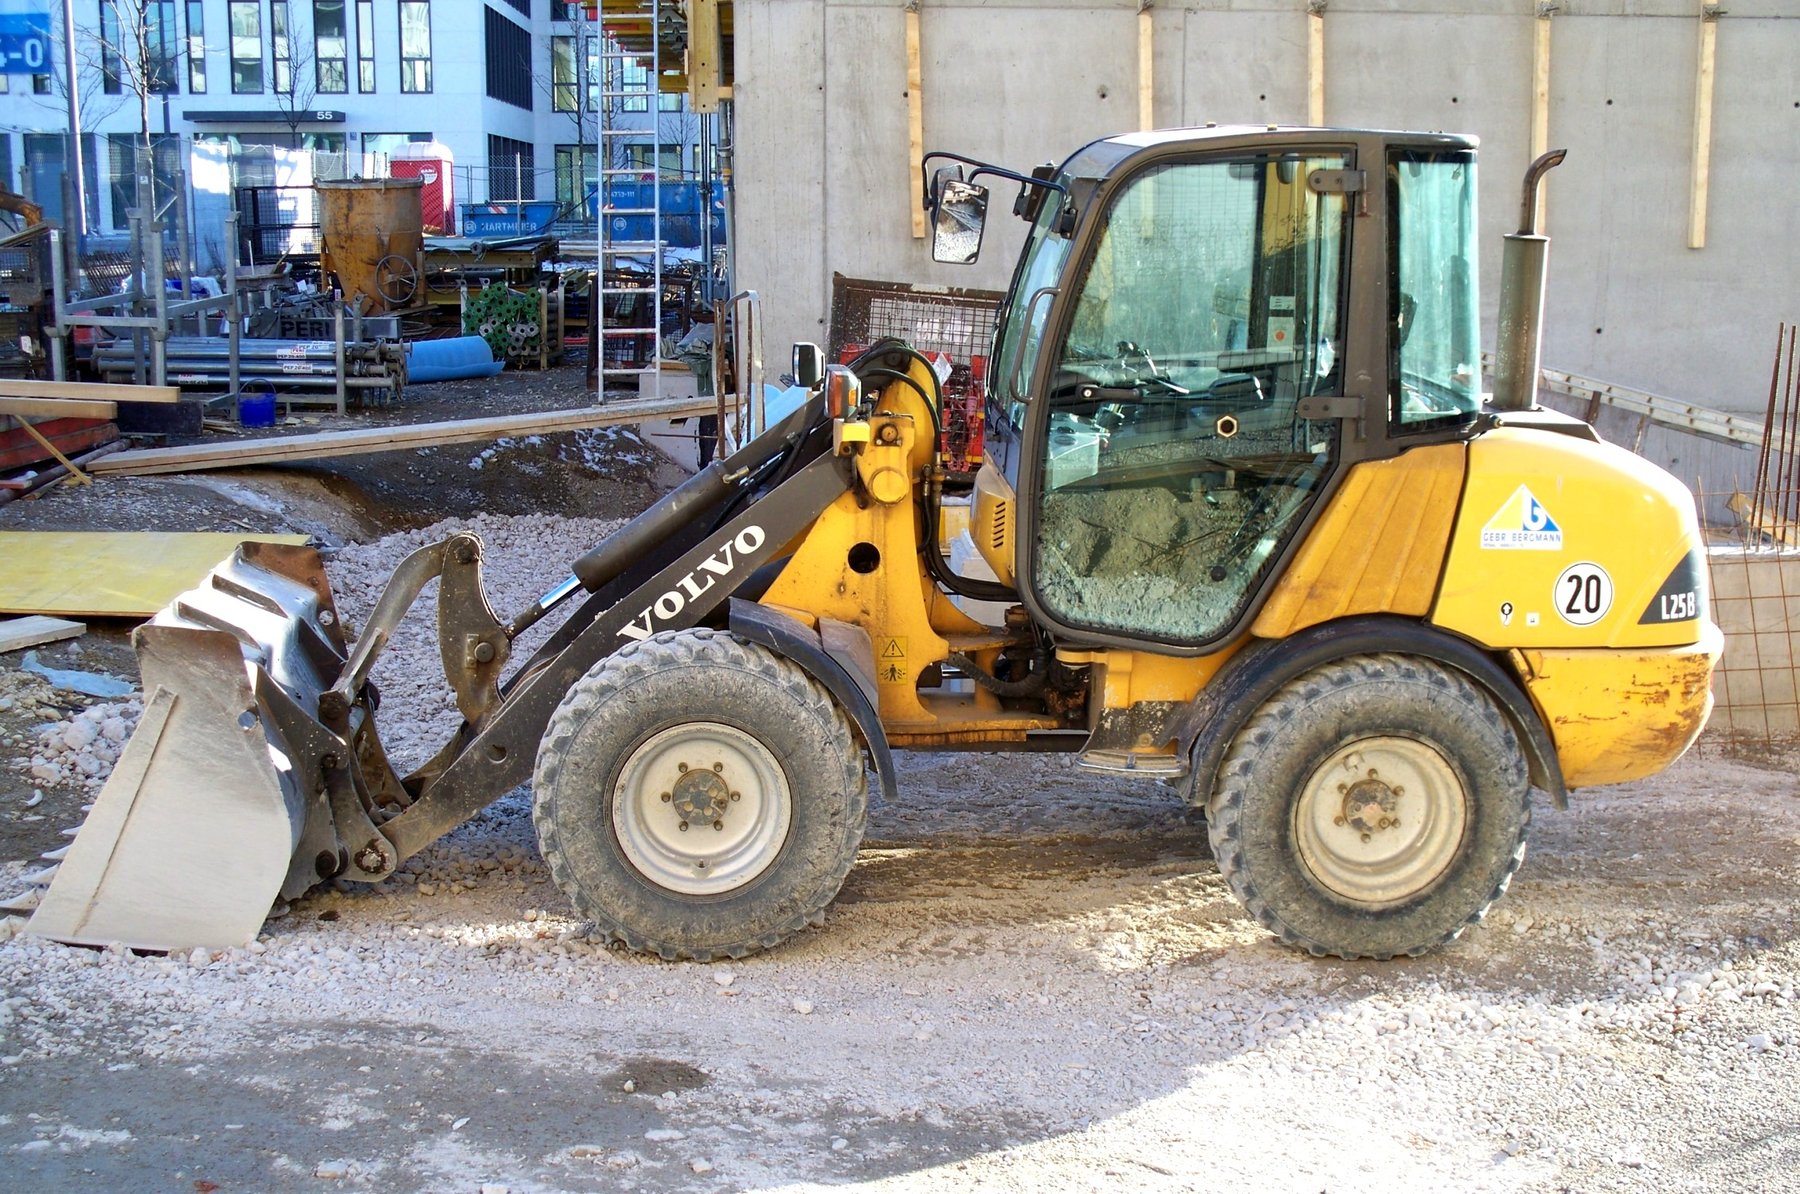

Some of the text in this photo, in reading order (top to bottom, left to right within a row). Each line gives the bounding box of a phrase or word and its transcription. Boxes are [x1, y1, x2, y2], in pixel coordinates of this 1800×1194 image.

[316, 111, 333, 120] 55
[281, 321, 330, 337] PERI
[1483, 532, 1561, 542] GEBR BERGMANN
[615, 525, 766, 641] VOLVO
[1565, 574, 1601, 614] 20
[1661, 592, 1696, 620] L25B
